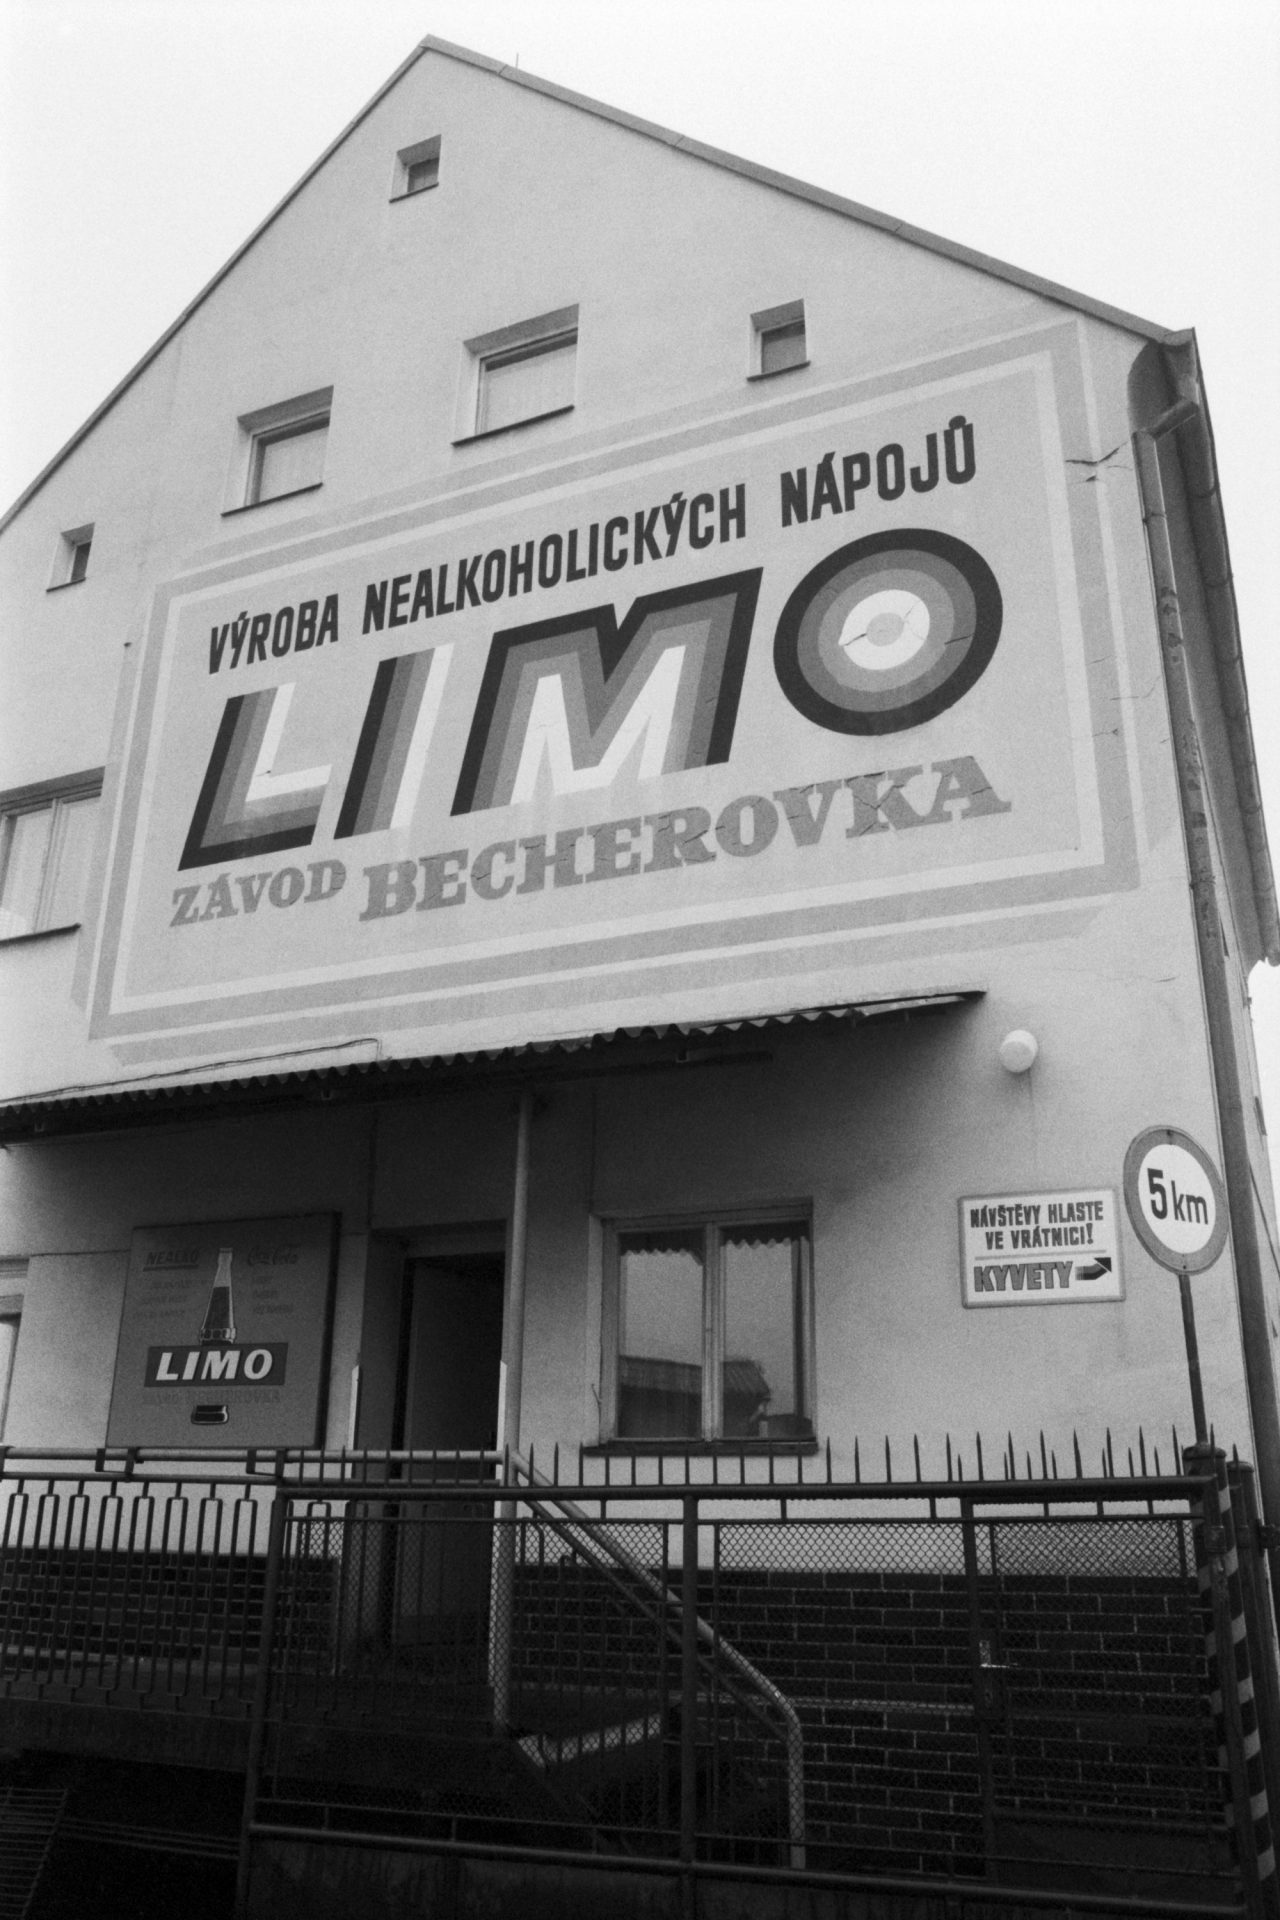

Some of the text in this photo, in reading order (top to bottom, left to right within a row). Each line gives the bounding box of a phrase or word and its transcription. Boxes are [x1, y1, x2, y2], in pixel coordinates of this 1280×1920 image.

[208, 415, 976, 675] VÝROBA NEALKOHOLICKÝCH NÁPOJŮ
[177, 528, 1004, 872] LIMO
[169, 755, 1012, 928] ZÁVOD BECHEROVKA
[970, 1201, 1104, 1228] NÁVŠTĚVY HLASTE
[1147, 1168, 1210, 1225] 5 km
[985, 1222, 1094, 1250] VE VRÁTNICI!
[973, 1261, 1074, 1293] KYVETY
[155, 1349, 273, 1381] LIMO
